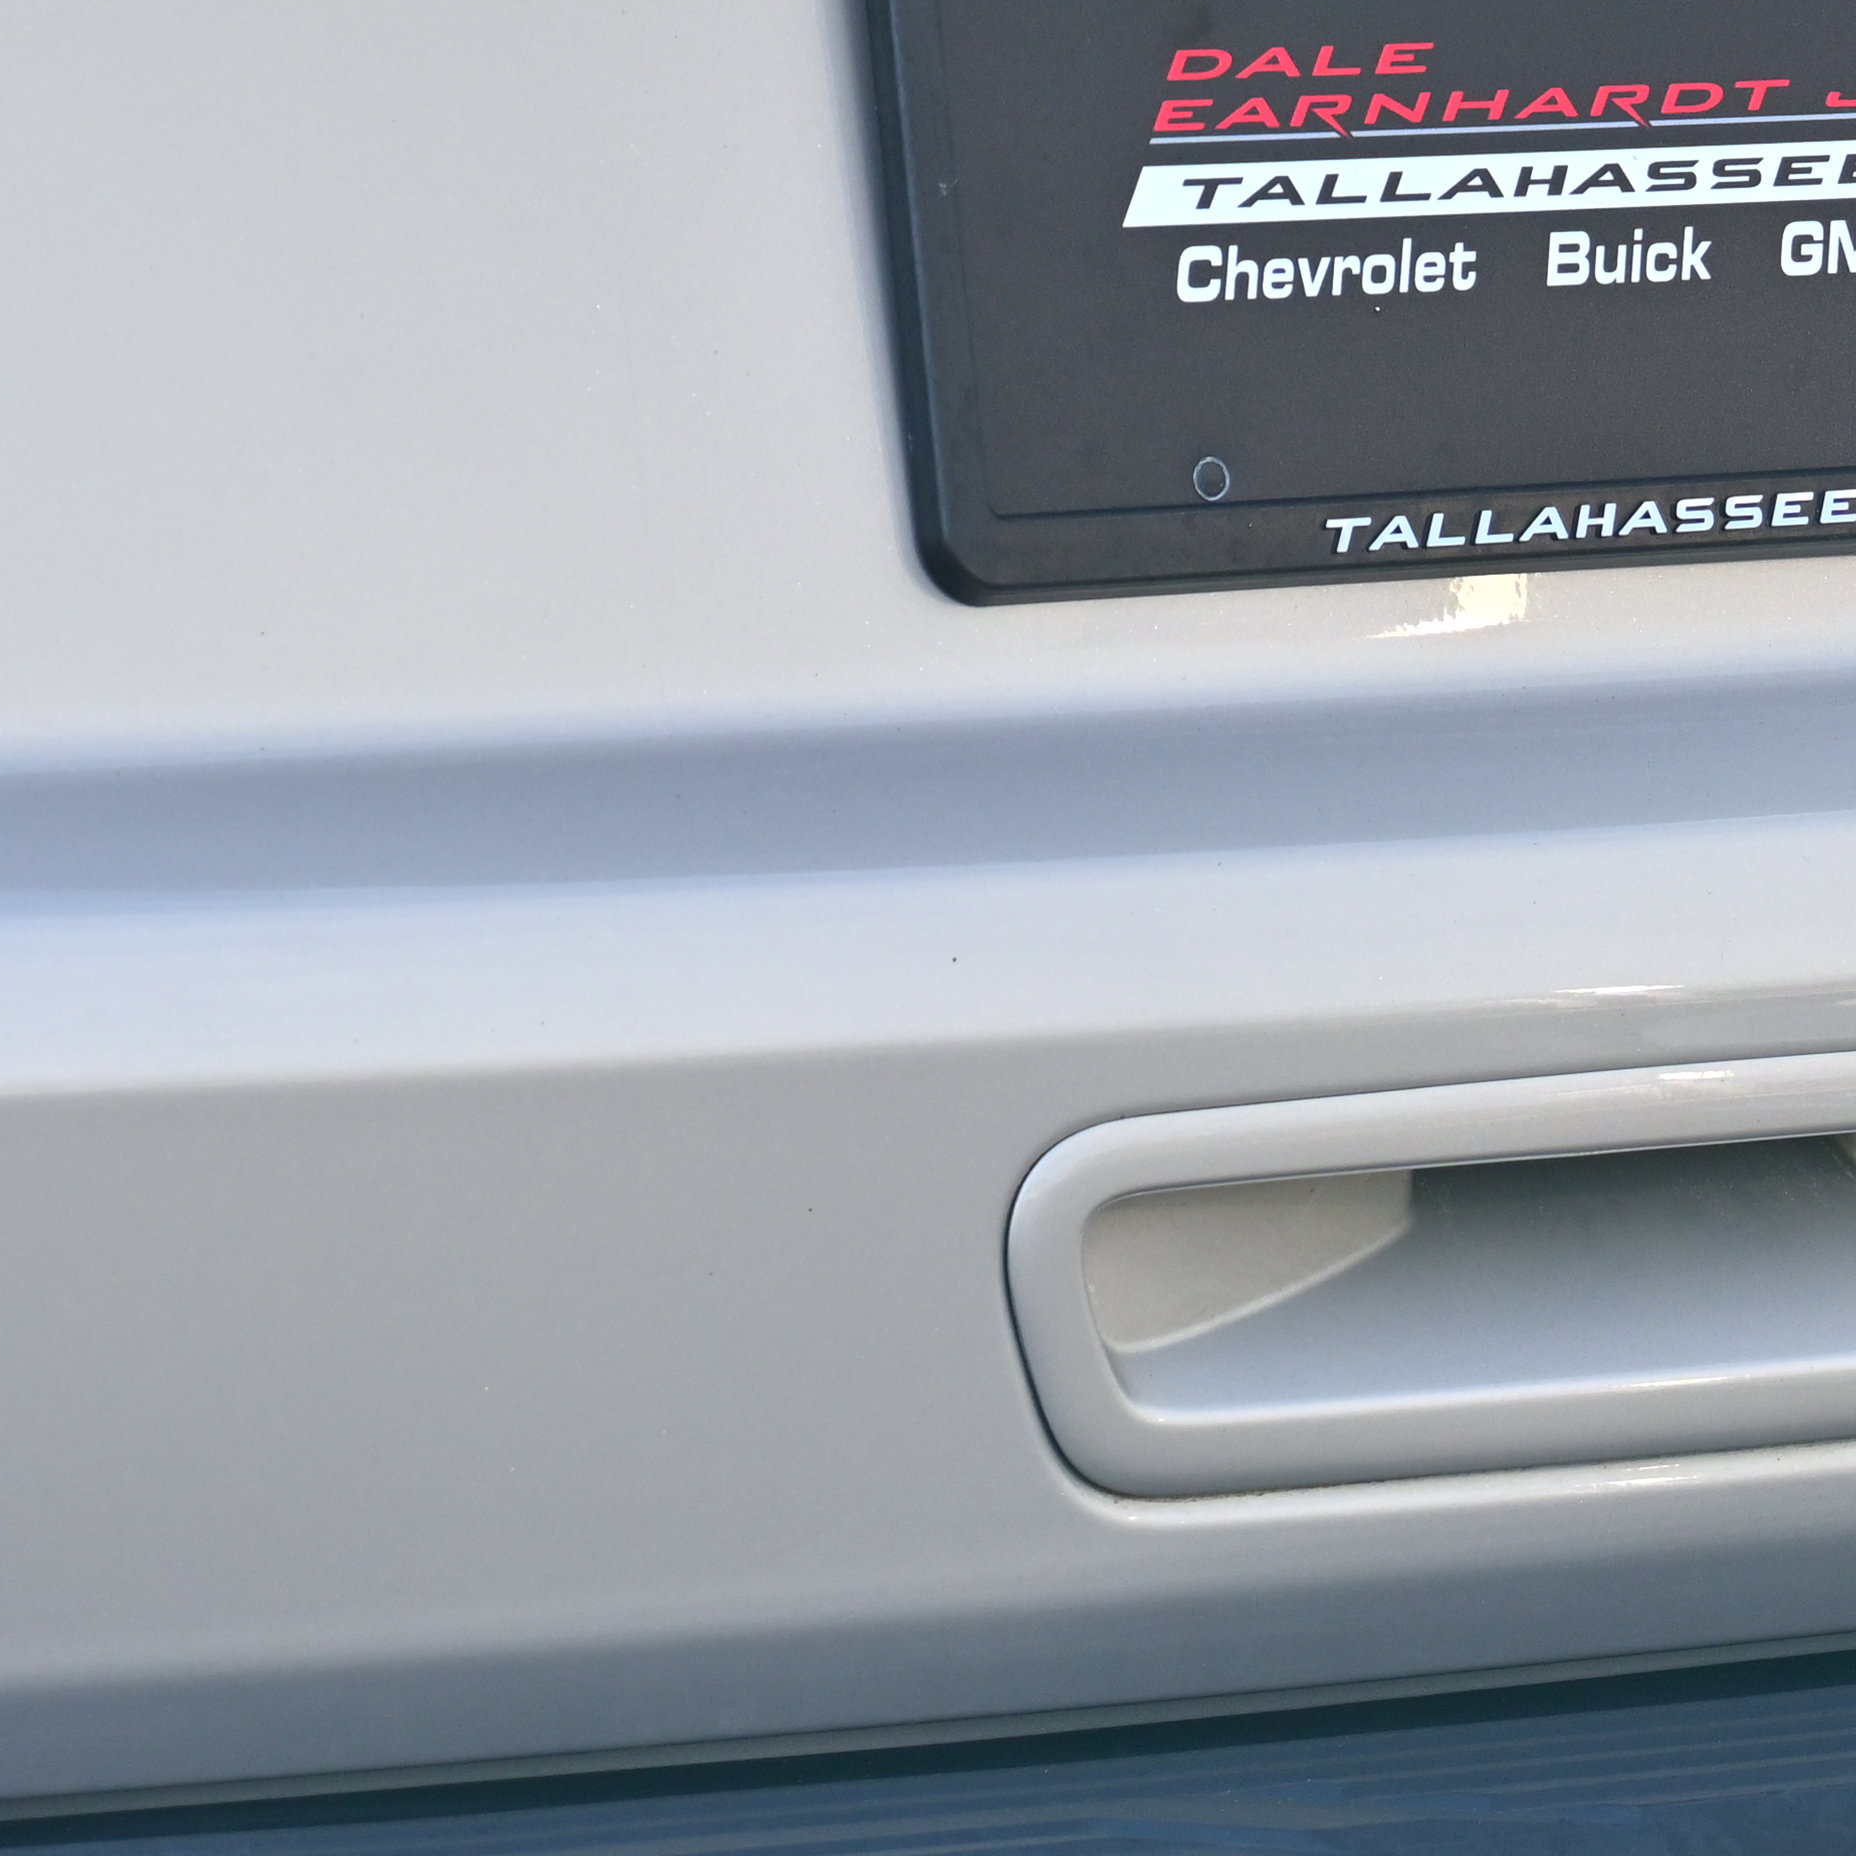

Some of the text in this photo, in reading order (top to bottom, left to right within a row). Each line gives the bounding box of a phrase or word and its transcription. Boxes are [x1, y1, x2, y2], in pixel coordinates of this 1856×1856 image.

[1167, 41, 1436, 82] DALE
[1153, 78, 1792, 137] EARNHARDT
[1176, 237, 1477, 303] Chevrolet
[1546, 225, 1712, 287] Buick
